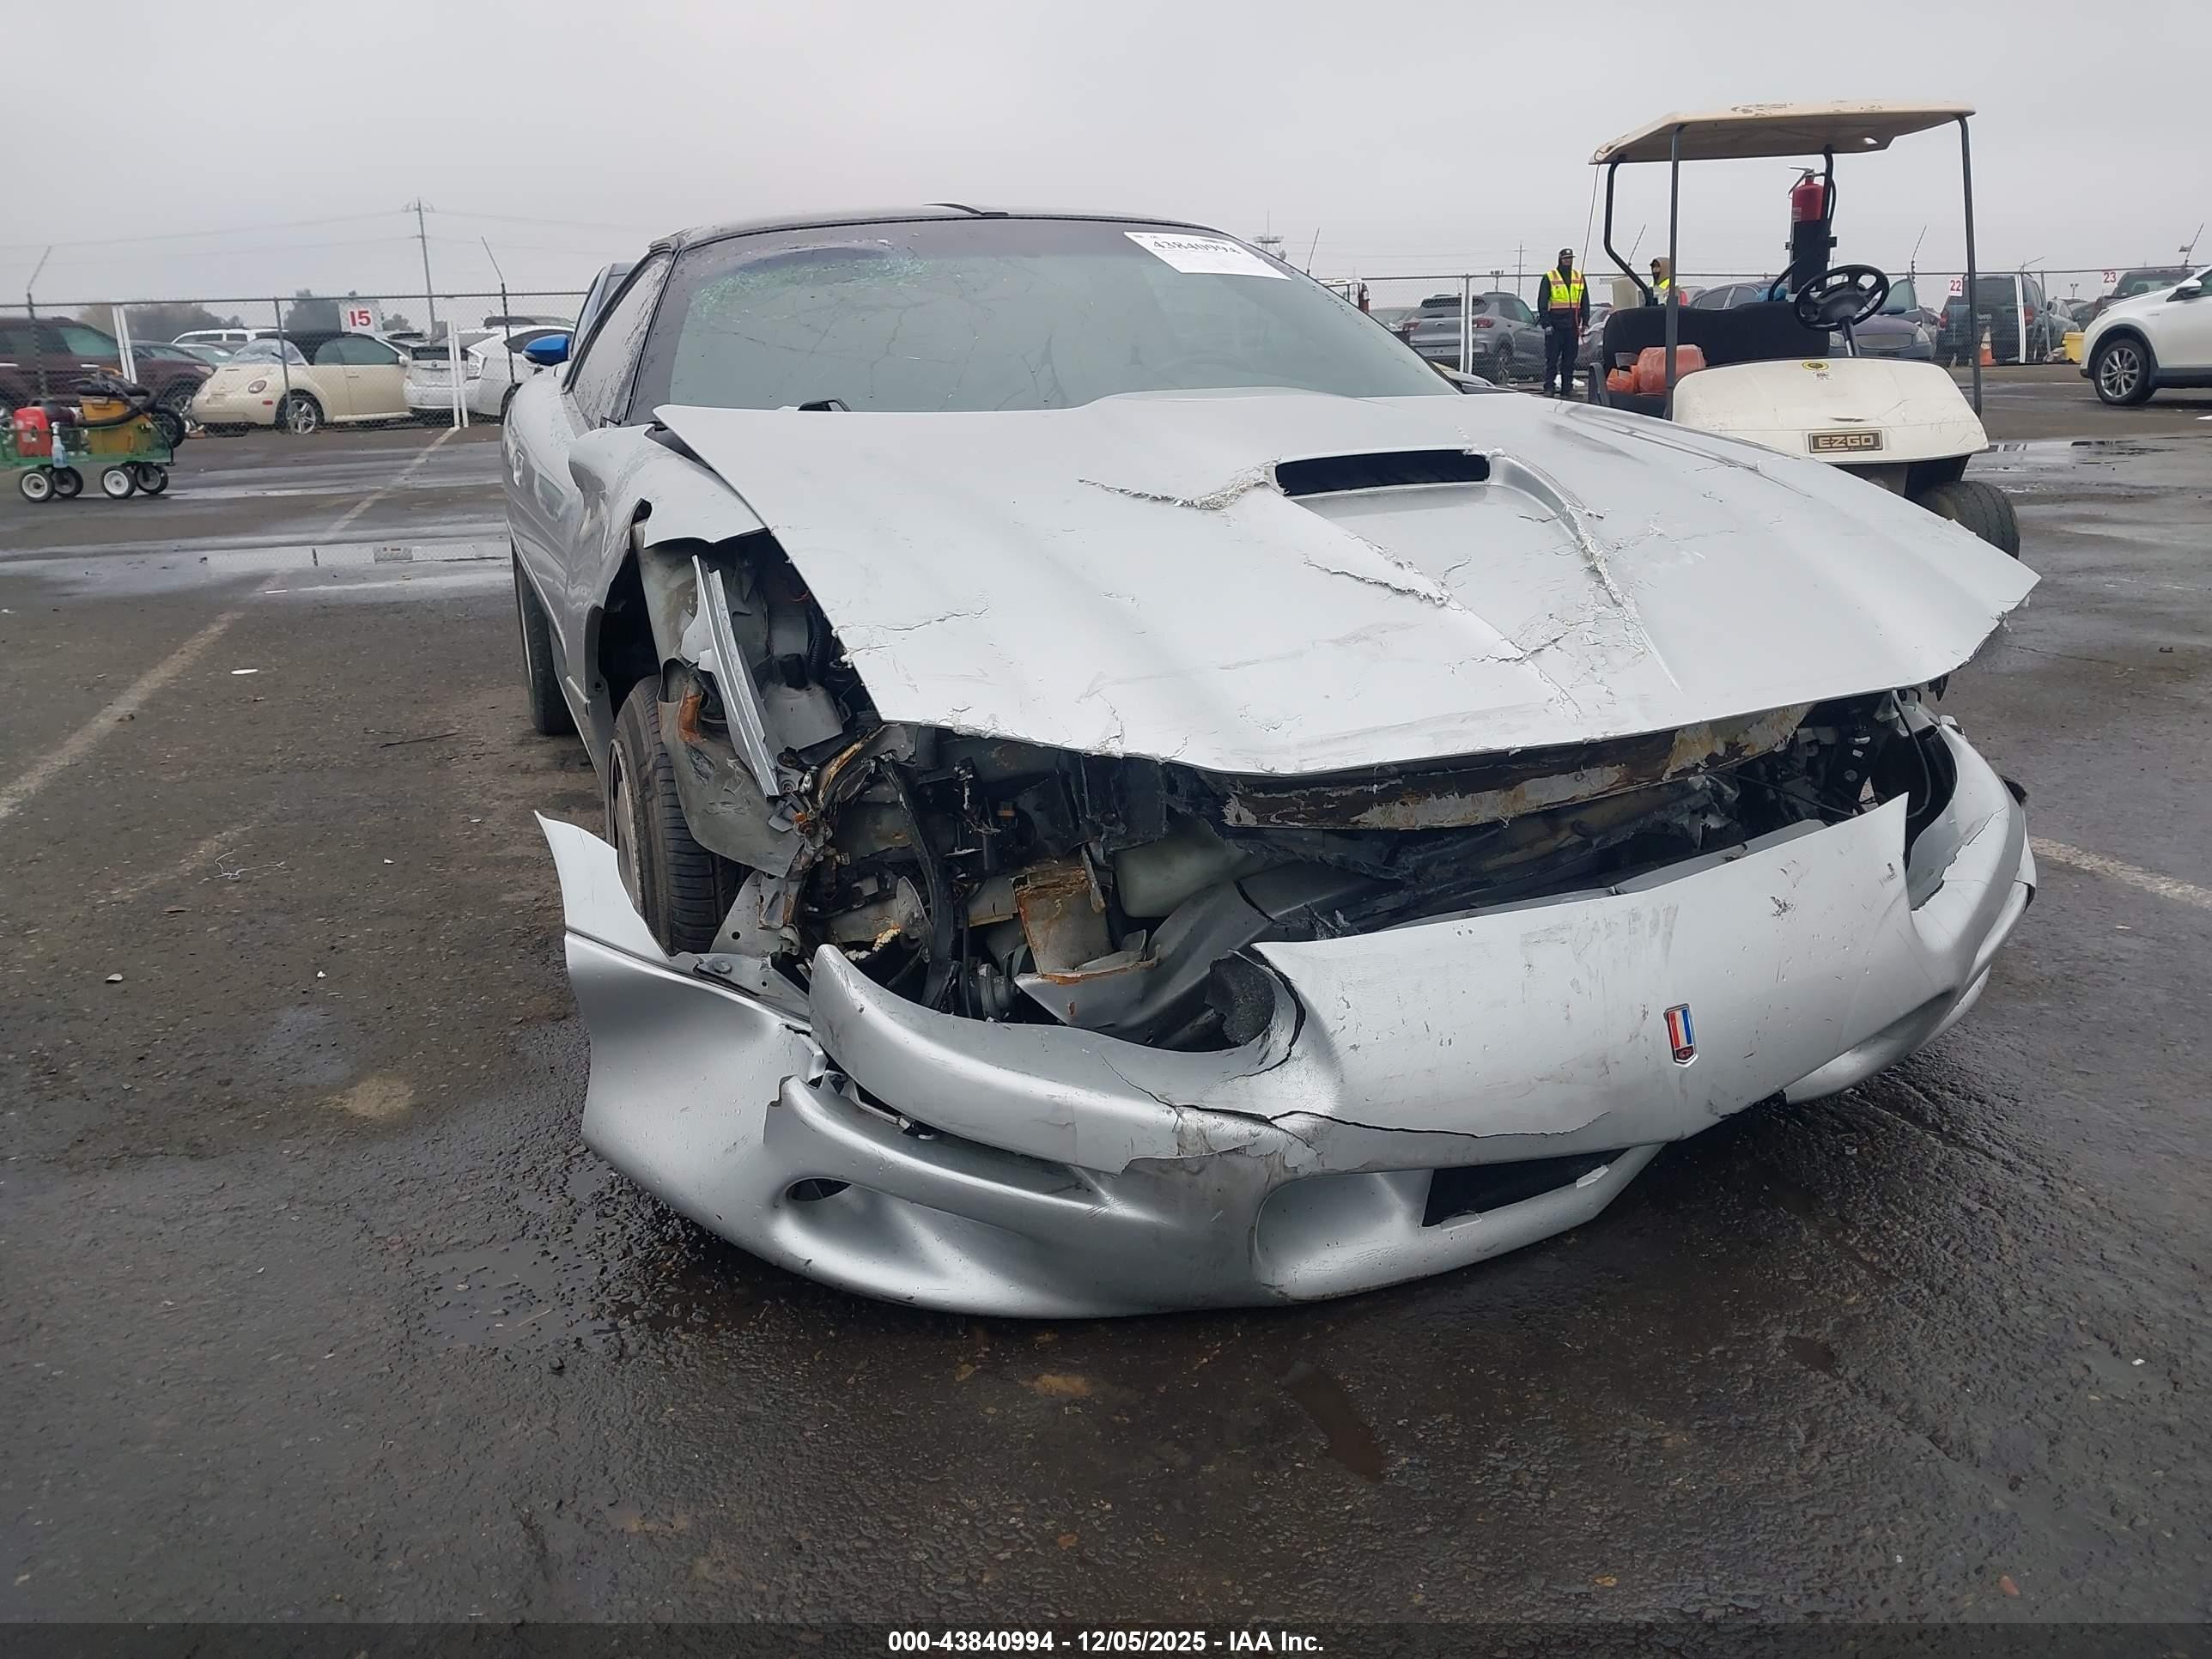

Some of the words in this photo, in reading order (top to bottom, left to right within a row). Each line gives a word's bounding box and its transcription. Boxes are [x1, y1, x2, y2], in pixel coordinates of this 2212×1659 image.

[2103, 271, 2117, 283] 23
[1949, 279, 1962, 292] 22
[349, 310, 372, 327] 15
[1817, 434, 1875, 448] EZGO
